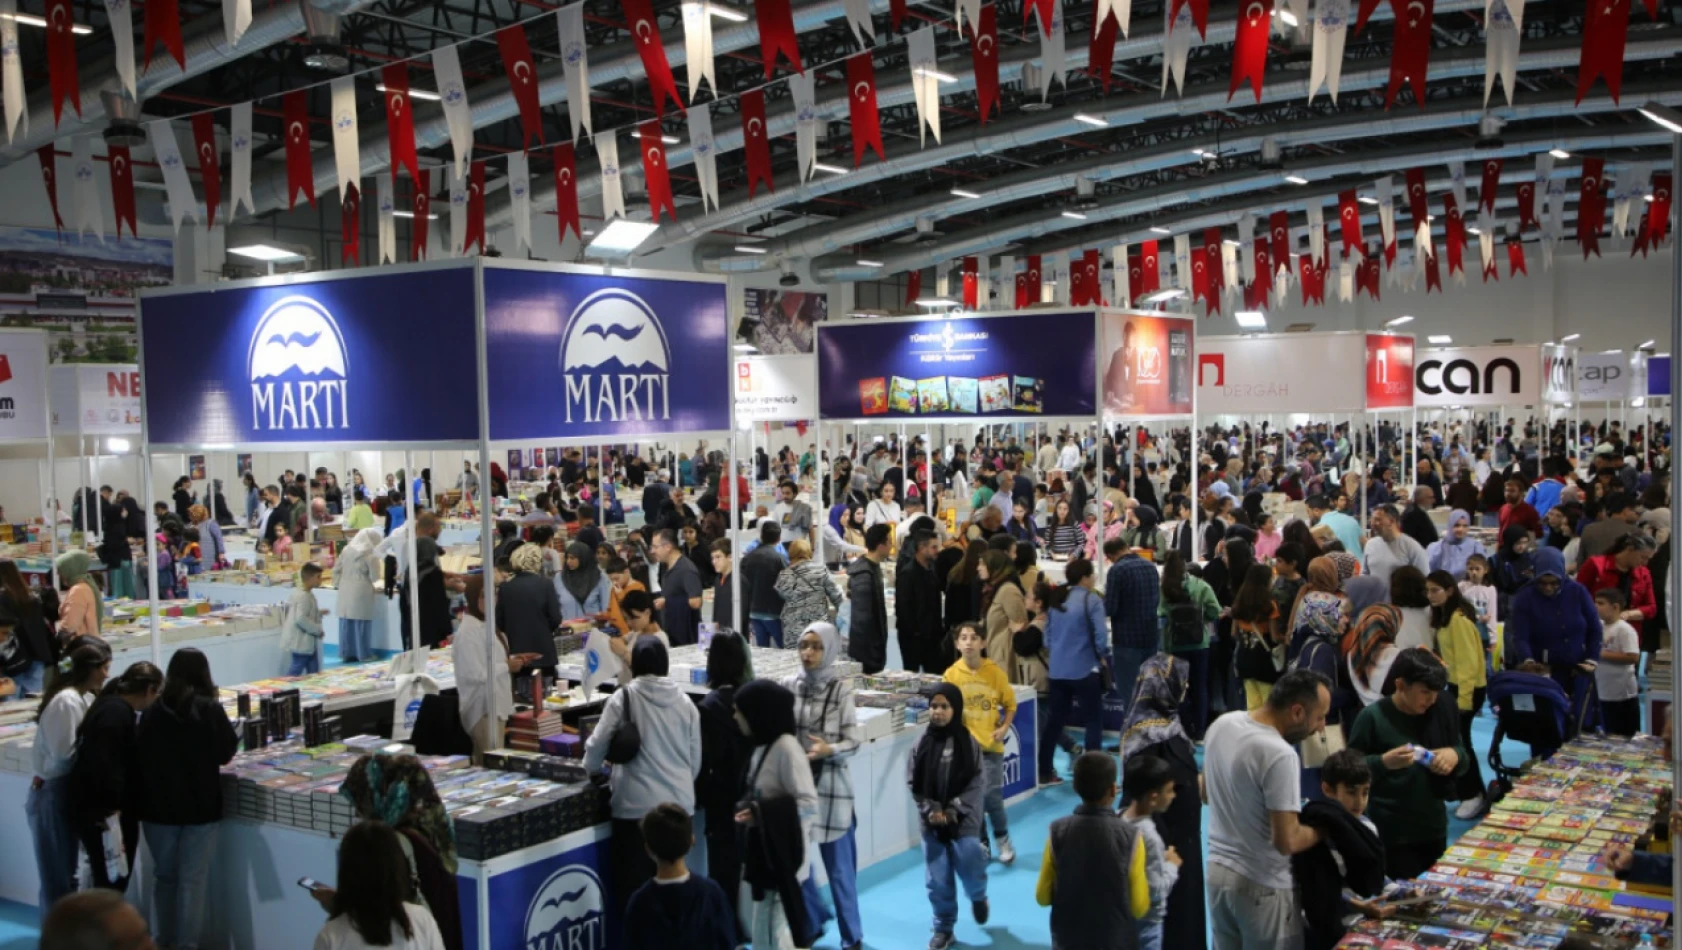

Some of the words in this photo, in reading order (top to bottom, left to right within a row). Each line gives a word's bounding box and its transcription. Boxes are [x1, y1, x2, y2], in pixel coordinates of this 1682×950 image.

[564, 373, 670, 423] MARTI
[1416, 357, 1521, 395] can
[251, 379, 349, 430] MARTI
[527, 915, 606, 950] ARTI
